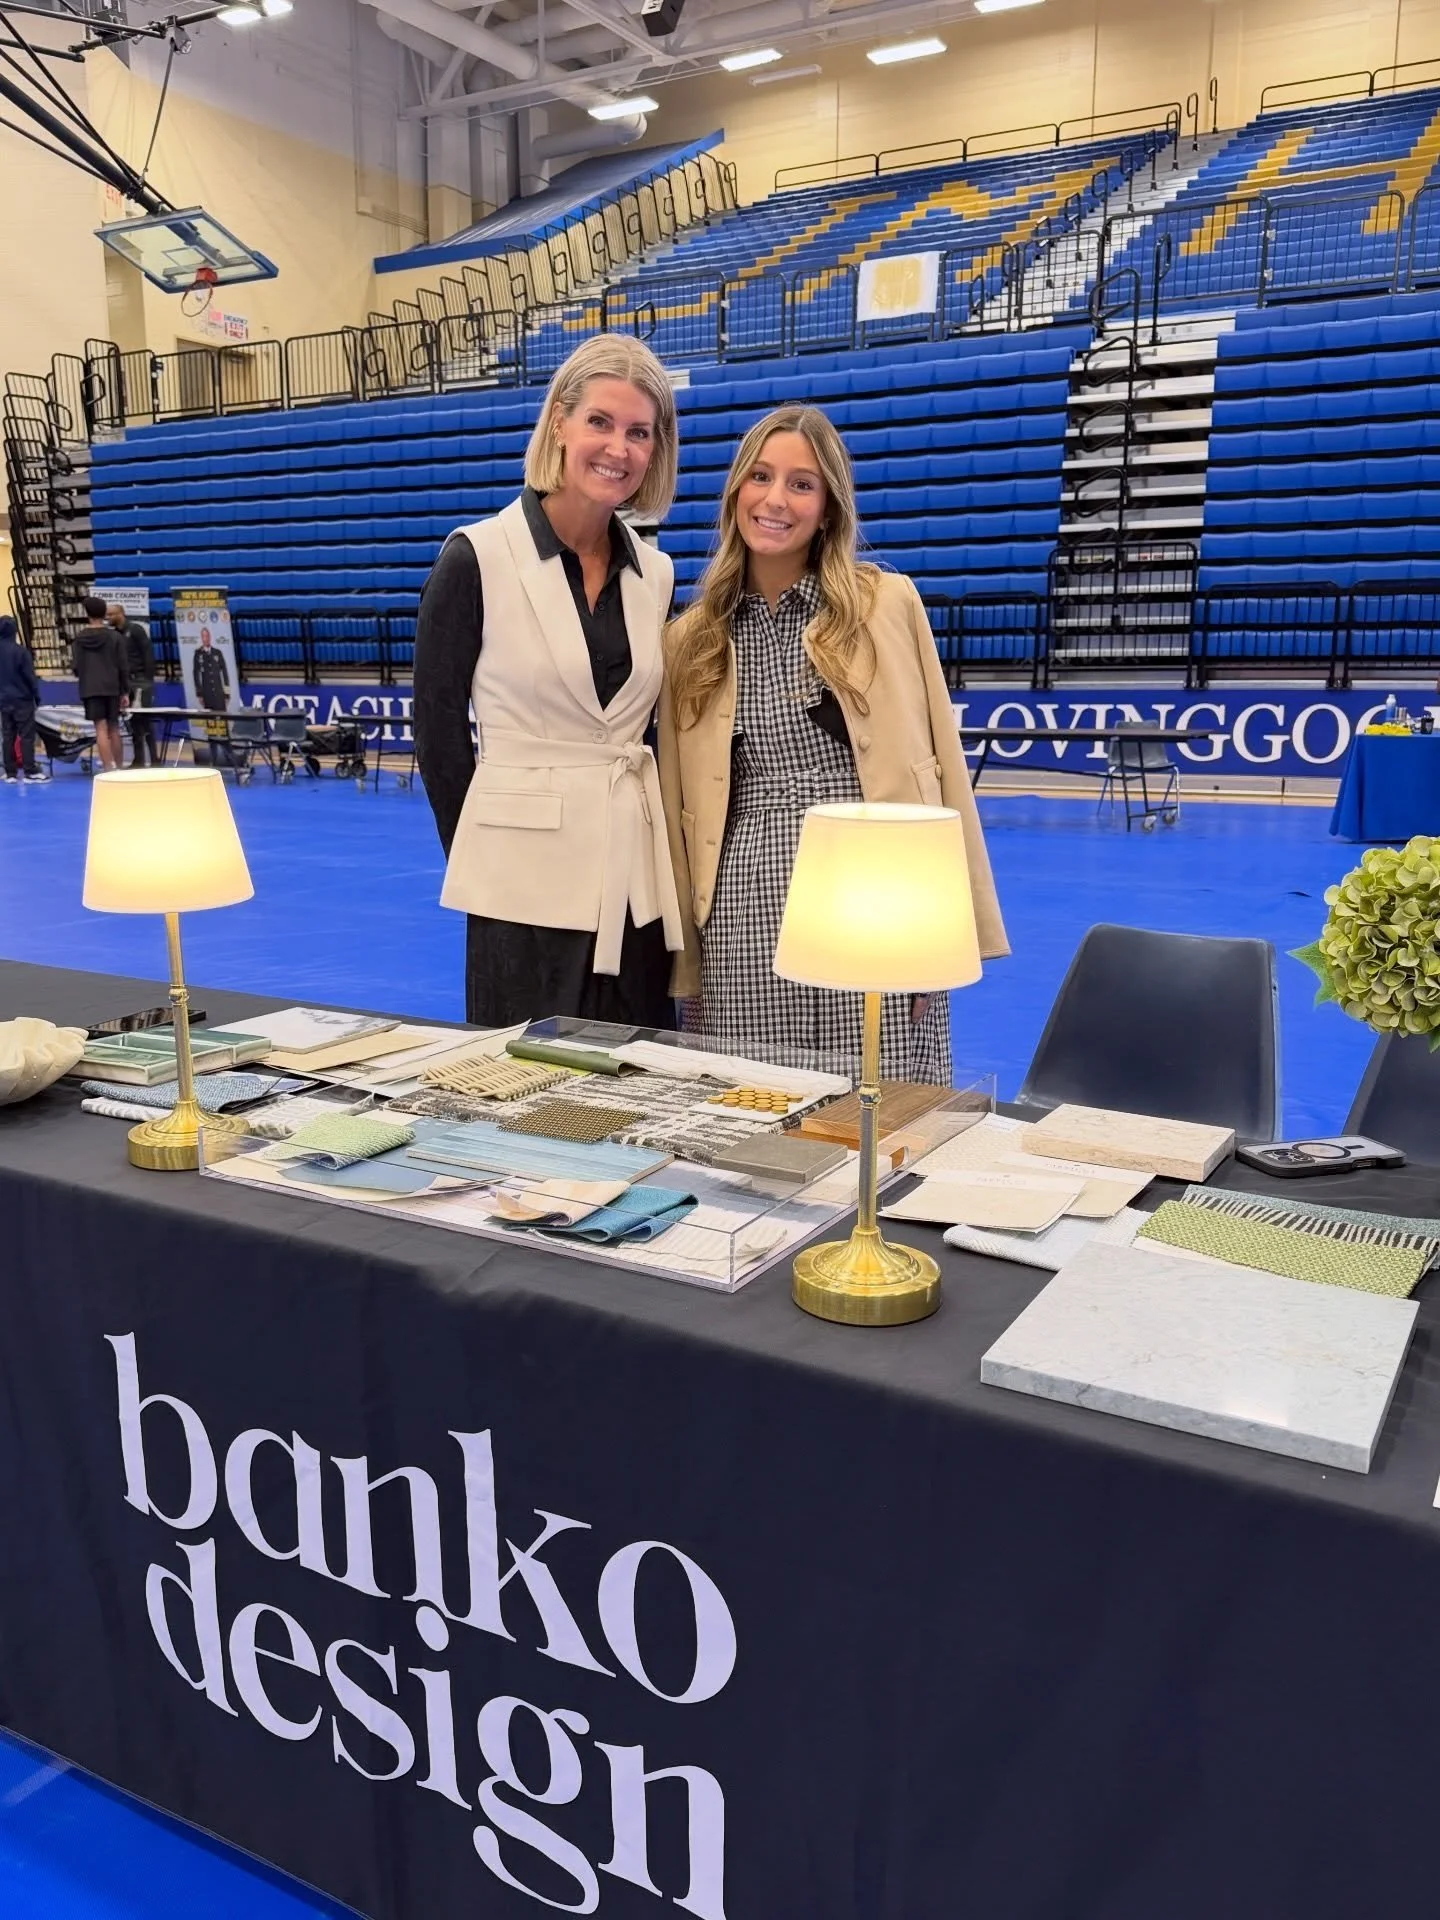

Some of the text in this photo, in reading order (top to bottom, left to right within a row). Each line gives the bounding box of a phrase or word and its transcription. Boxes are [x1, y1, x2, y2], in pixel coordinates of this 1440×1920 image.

[114, 591, 146, 599] COUNTY
[104, 1332, 737, 1704] banko
[146, 1538, 726, 1920] design
